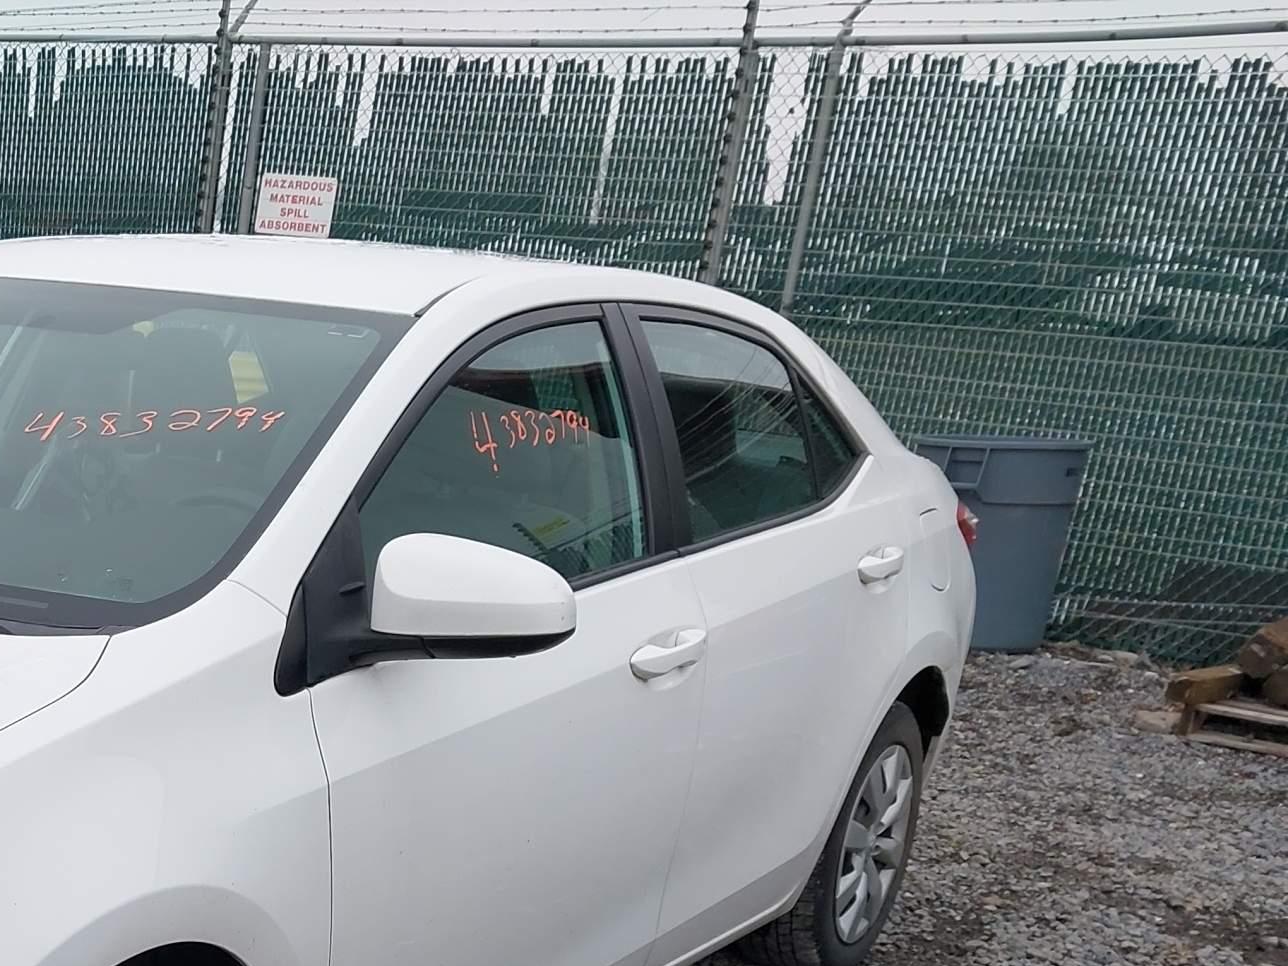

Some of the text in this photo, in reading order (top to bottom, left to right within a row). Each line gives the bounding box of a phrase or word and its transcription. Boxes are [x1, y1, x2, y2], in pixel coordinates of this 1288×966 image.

[264, 178, 334, 193] HAZARDOUS
[269, 193, 324, 206] MATERIAL
[279, 207, 310, 218] SPILL
[259, 219, 327, 233] ABSORBENT
[23, 406, 286, 441] 43832794
[470, 409, 591, 472] 43832794
